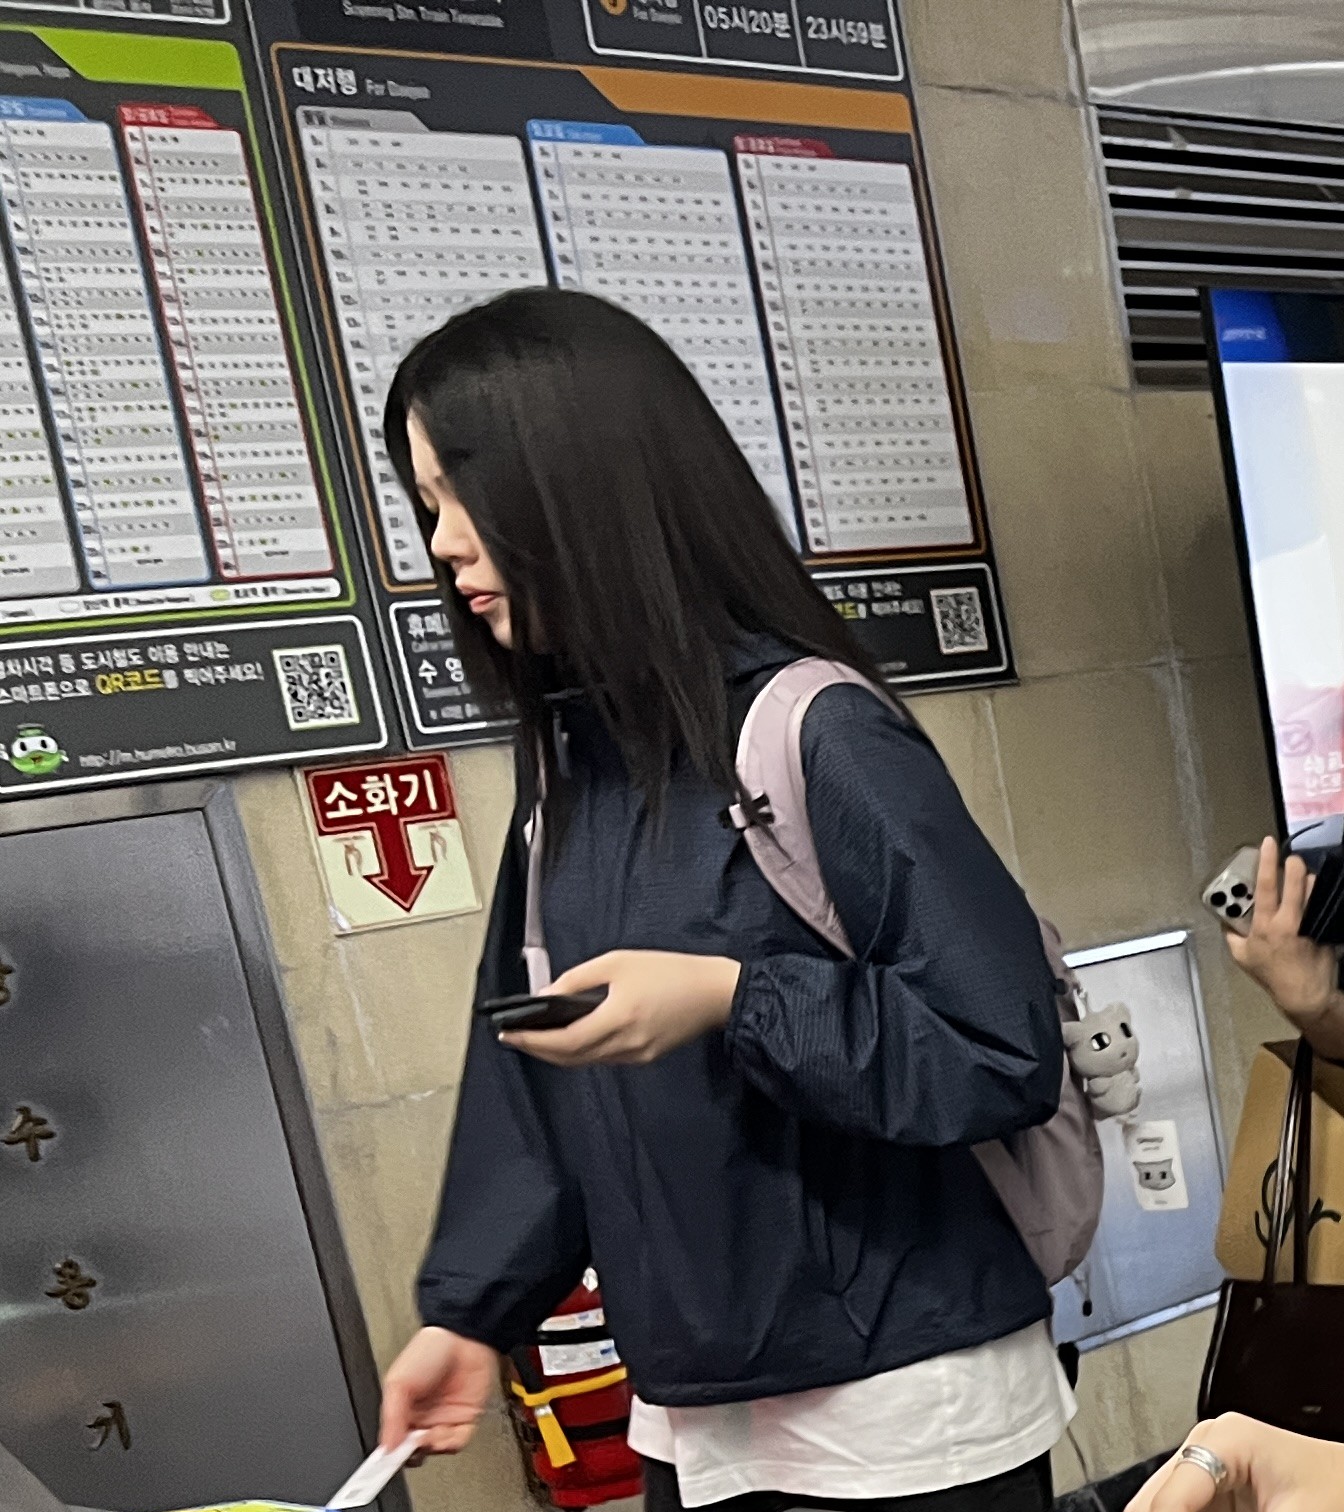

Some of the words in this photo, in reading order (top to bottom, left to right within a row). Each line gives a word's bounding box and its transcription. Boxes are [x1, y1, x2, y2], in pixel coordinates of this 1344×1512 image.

[704, 5, 791, 39] 05시20분
[292, 66, 357, 96] 대저행
[324, 769, 438, 819] 소화기
